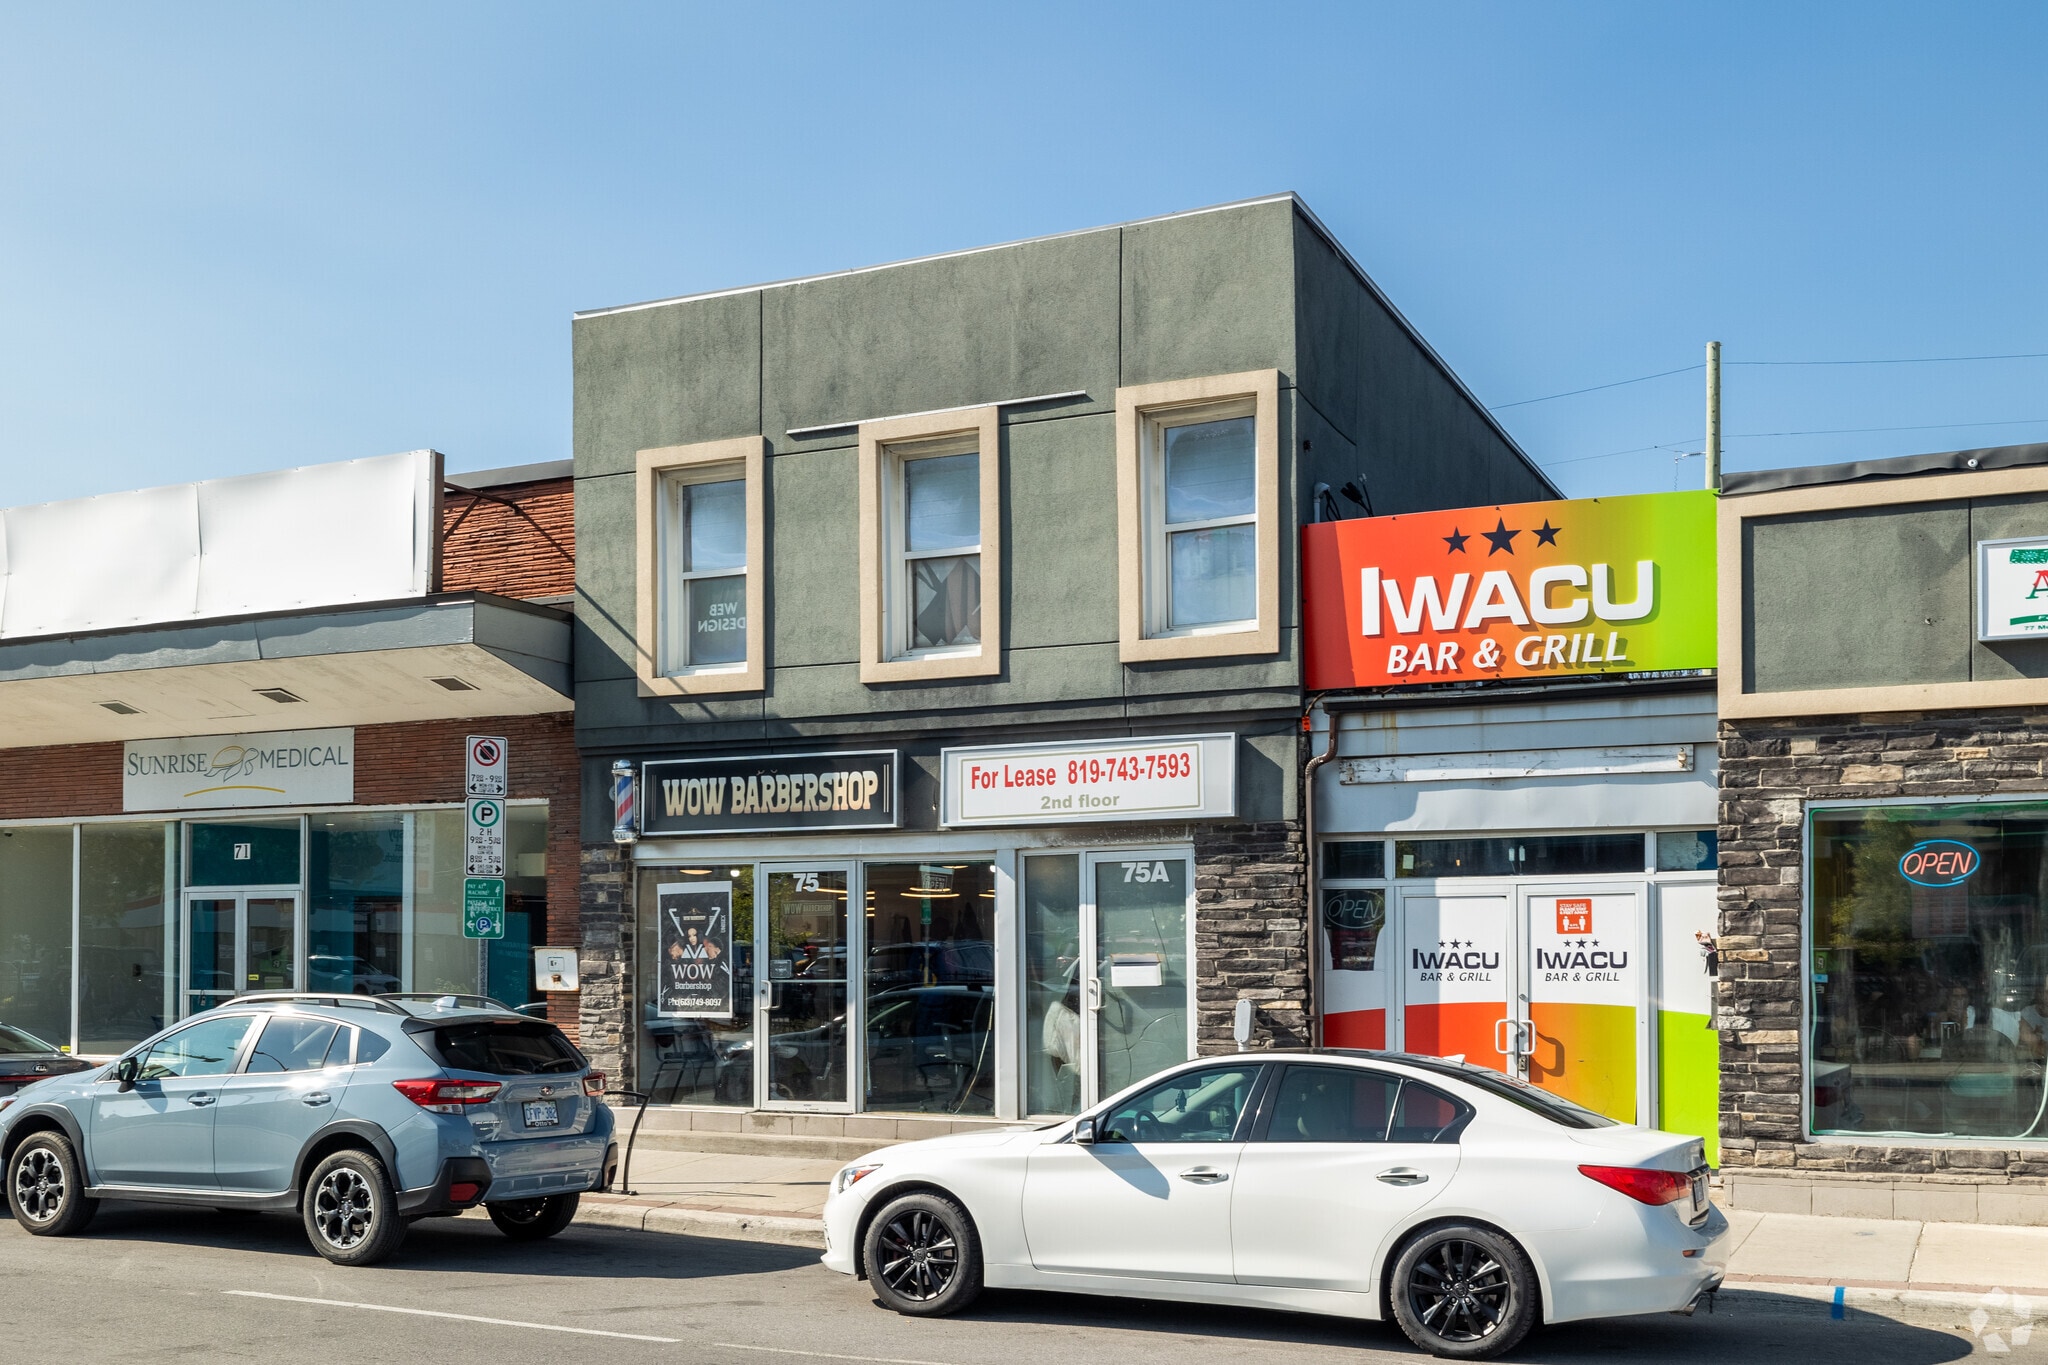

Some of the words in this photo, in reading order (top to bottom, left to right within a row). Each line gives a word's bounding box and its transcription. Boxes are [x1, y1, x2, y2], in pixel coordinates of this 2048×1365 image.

[1361, 560, 1654, 636] IWACU
[1387, 641, 1459, 674] BAR
[1472, 638, 1501, 669] &
[1515, 632, 1627, 666] GRILL
[127, 753, 207, 776] SUNRISE
[260, 746, 348, 769] MEDICAL
[971, 766, 998, 789] For
[1004, 764, 1056, 788] Lease
[1068, 752, 1191, 784] 819-743-7593
[662, 777, 727, 817] WOW
[731, 770, 879, 815] BARBERSHOP
[1040, 795, 1072, 810] 2nd
[1078, 794, 1120, 808] floor
[481, 807, 493, 821] P
[480, 828, 484, 836] 2
[487, 828, 492, 836] H
[235, 845, 248, 858] 71
[1121, 862, 1170, 883] 75A
[1903, 851, 1972, 875] OPEN
[792, 872, 819, 893] 75
[783, 903, 802, 915] WOW
[1328, 899, 1381, 918] OPEN
[1412, 948, 1499, 970] IWACU
[1537, 947, 1628, 969] IWACU
[671, 963, 716, 980] WOW
[1420, 972, 1445, 982] BAR
[1447, 972, 1456, 982] &
[1458, 972, 1492, 982] GRILL
[1545, 972, 1571, 982] BAR
[1574, 972, 1582, 982] &
[1585, 972, 1620, 982] GRILL
[675, 981, 712, 991] Barbershop
